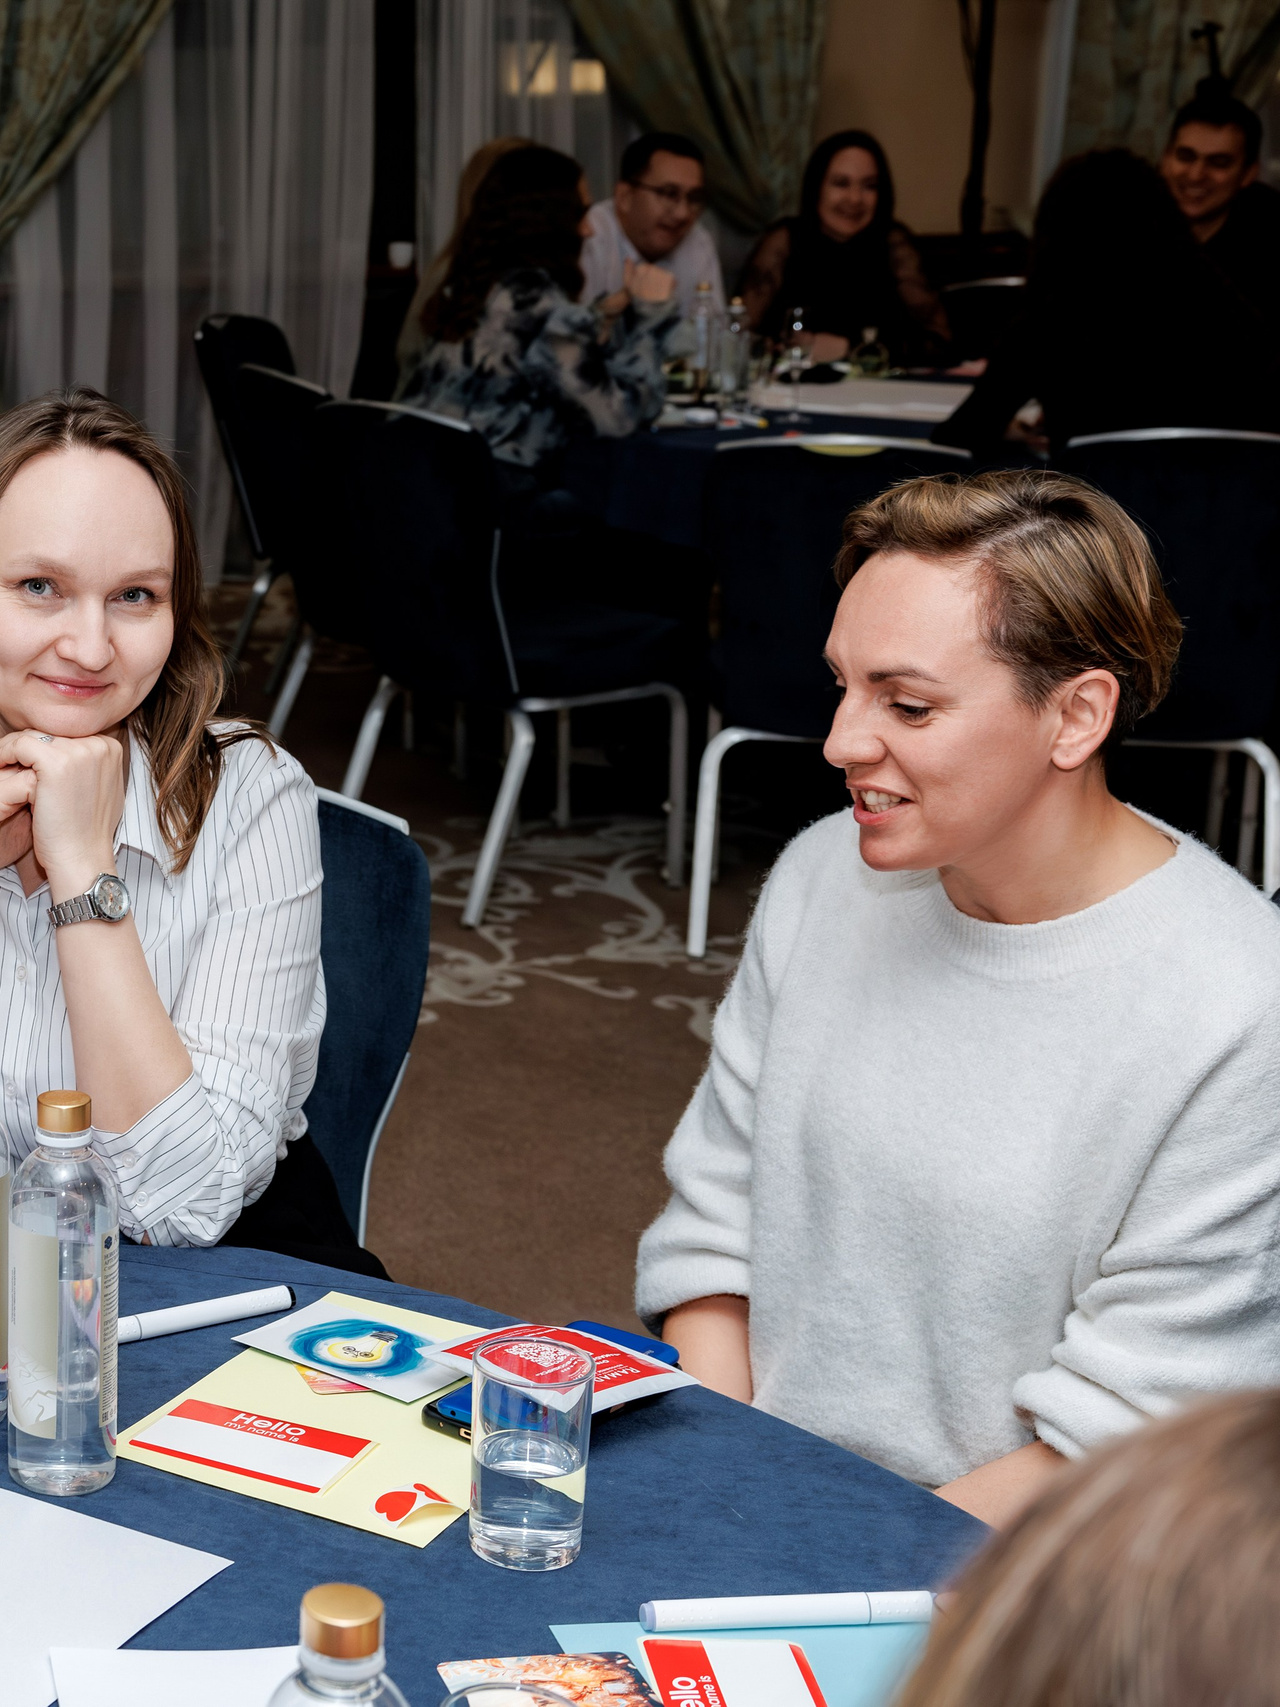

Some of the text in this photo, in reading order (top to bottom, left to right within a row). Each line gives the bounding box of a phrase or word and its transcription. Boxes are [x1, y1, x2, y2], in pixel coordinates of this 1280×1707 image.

[594, 1366, 641, 1383] RAMAD
[223, 1421, 246, 1430] my
[247, 1426, 287, 1439] name
[232, 1412, 306, 1436] Hello
[698, 1675, 712, 1683] is
[668, 1676, 705, 1707] ello
[703, 1683, 721, 1707] ame
